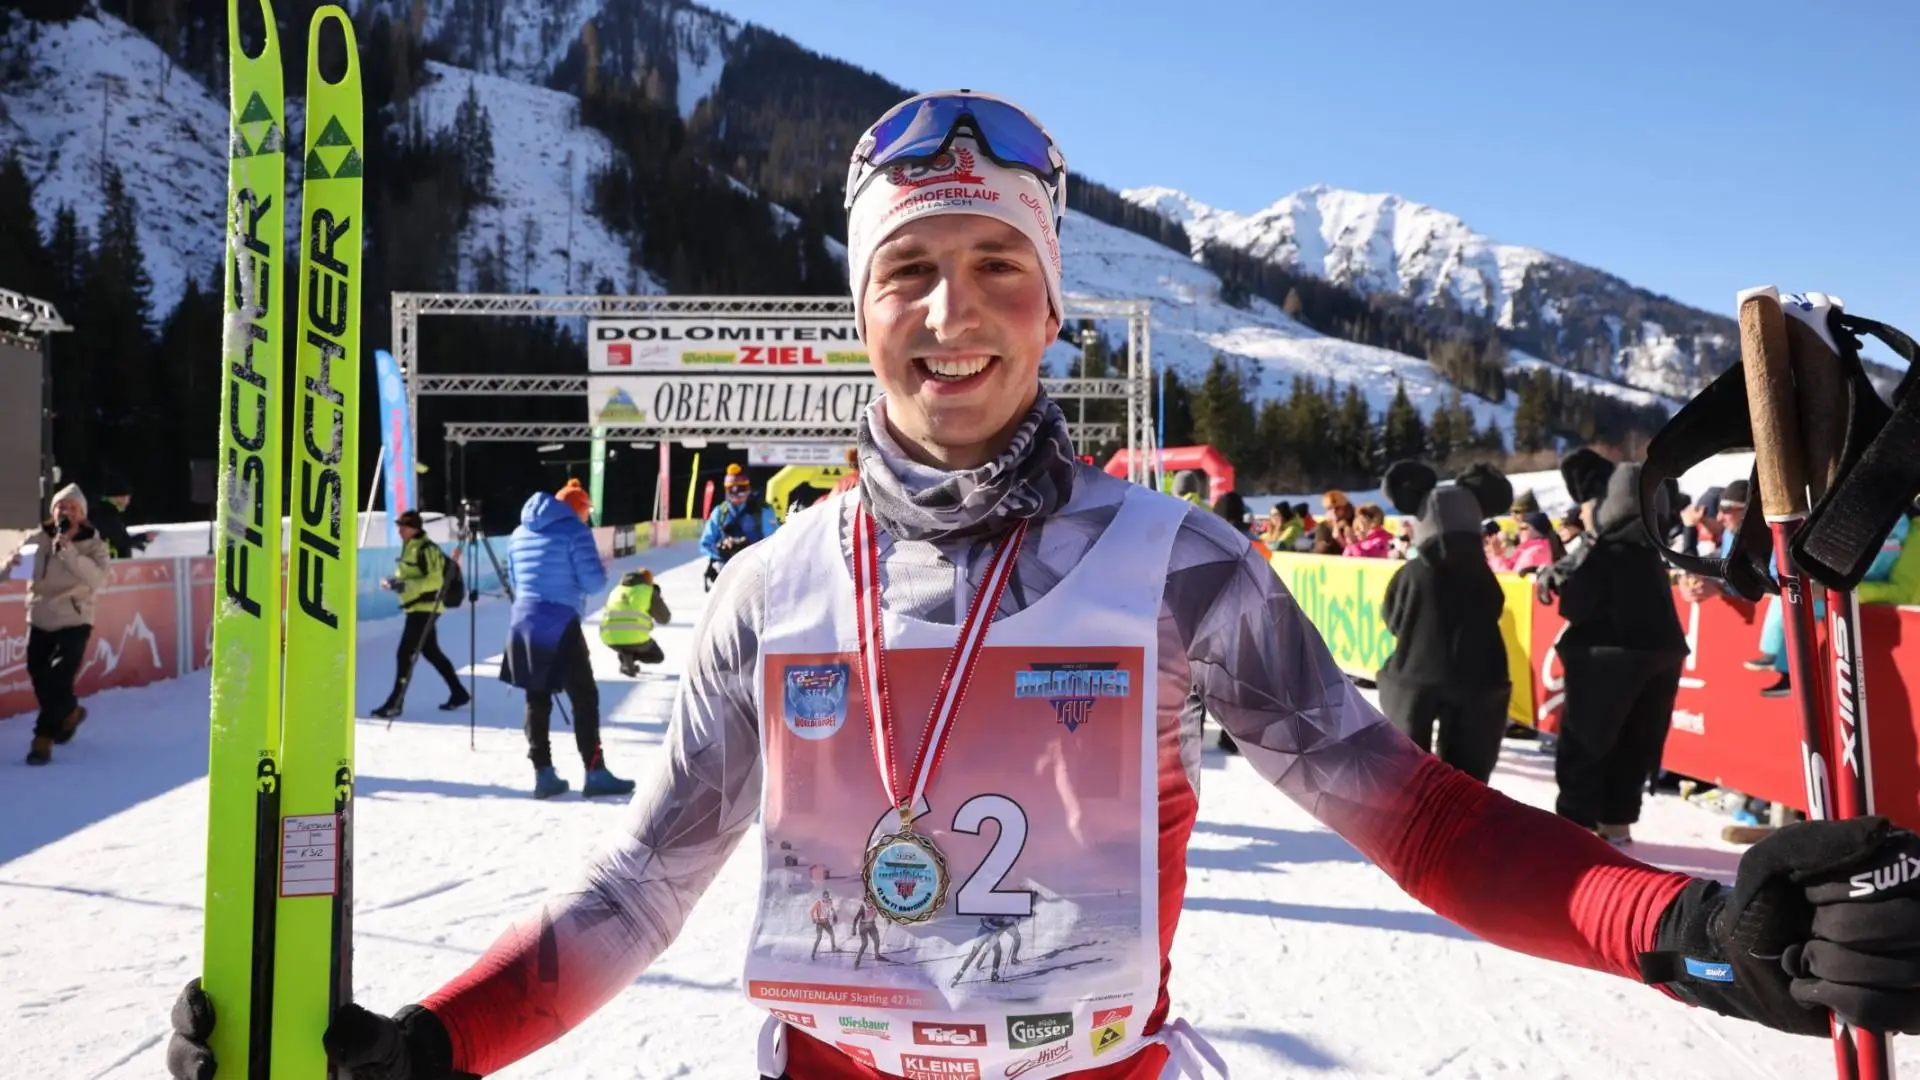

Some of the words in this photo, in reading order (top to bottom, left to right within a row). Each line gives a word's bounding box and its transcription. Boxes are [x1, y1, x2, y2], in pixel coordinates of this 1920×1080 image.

[739, 346, 822, 365] ZIEL
[226, 187, 272, 619] FISCHER
[653, 381, 874, 422] OBERTILLIACH
[298, 207, 351, 630] FISCHER
[1055, 700, 1092, 724] LAUF
[1849, 853, 1920, 898] swix
[760, 987, 848, 1002] DOLOMITENLAUF
[851, 992, 888, 1005] Skating
[891, 994, 903, 1005] 42
[905, 995, 923, 1007] km
[774, 1010, 811, 1026] ORF
[839, 1016, 889, 1031] Wiesbauer
[1011, 1020, 1070, 1043] Gösser
[905, 1057, 976, 1073] KLEINE
